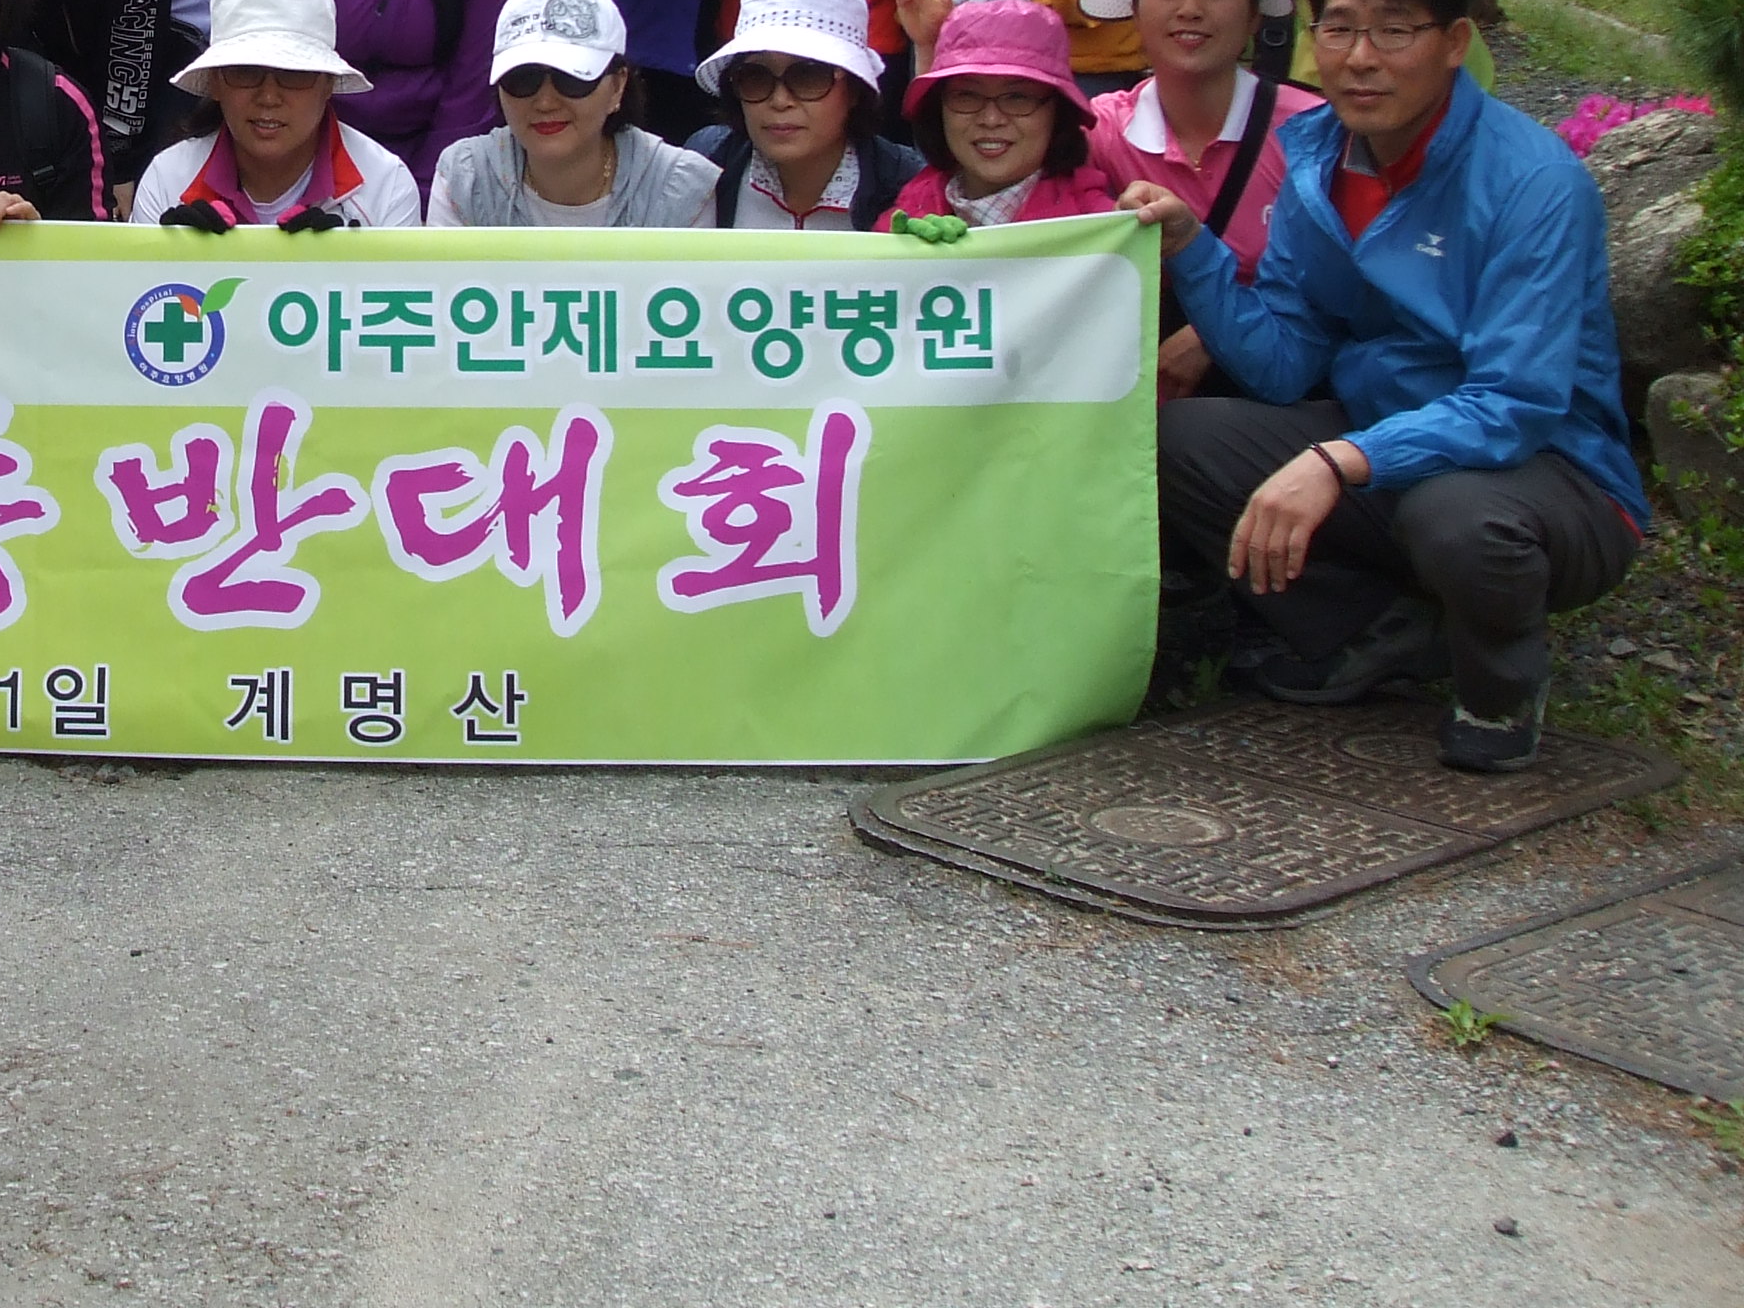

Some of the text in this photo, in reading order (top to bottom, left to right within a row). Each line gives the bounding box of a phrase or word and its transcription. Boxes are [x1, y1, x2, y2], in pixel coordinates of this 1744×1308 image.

[145, 8, 158, 38] FIVE
[137, 43, 153, 109] SECONDS
[267, 287, 995, 379] 아주안제요양병원
[225, 669, 527, 744] 계명산
